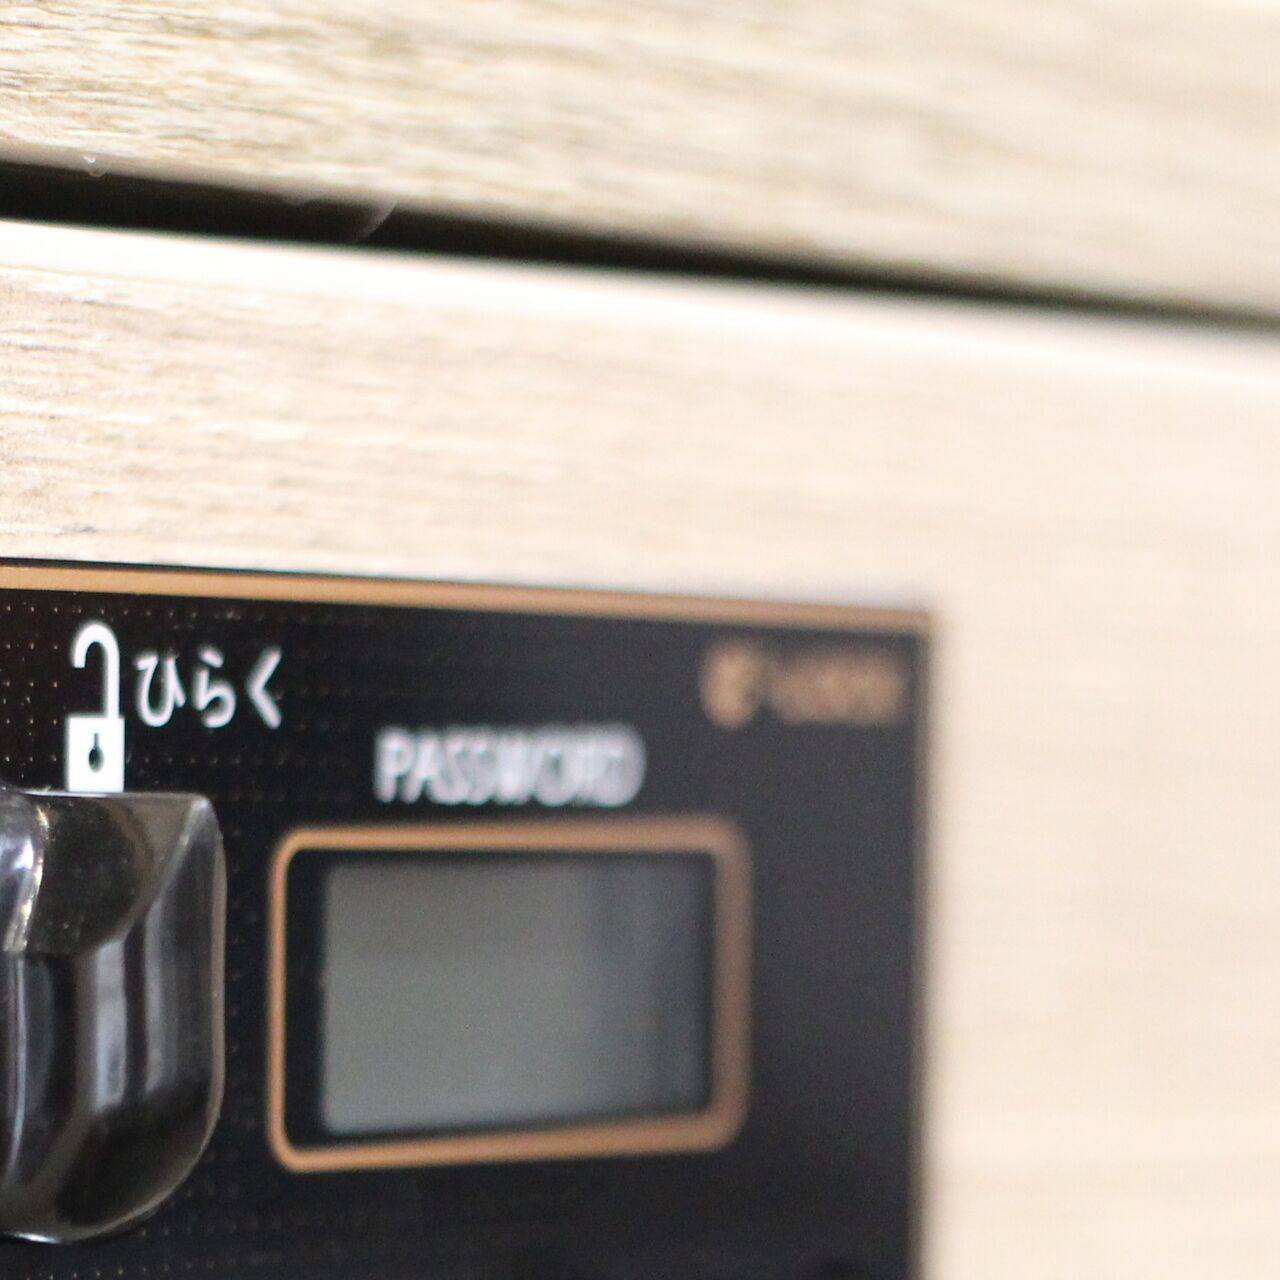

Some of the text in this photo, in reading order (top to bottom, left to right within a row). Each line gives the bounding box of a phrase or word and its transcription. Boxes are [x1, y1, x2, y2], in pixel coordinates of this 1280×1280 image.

[133, 645, 282, 730] ひらく
[375, 725, 647, 807] PASSWORD
